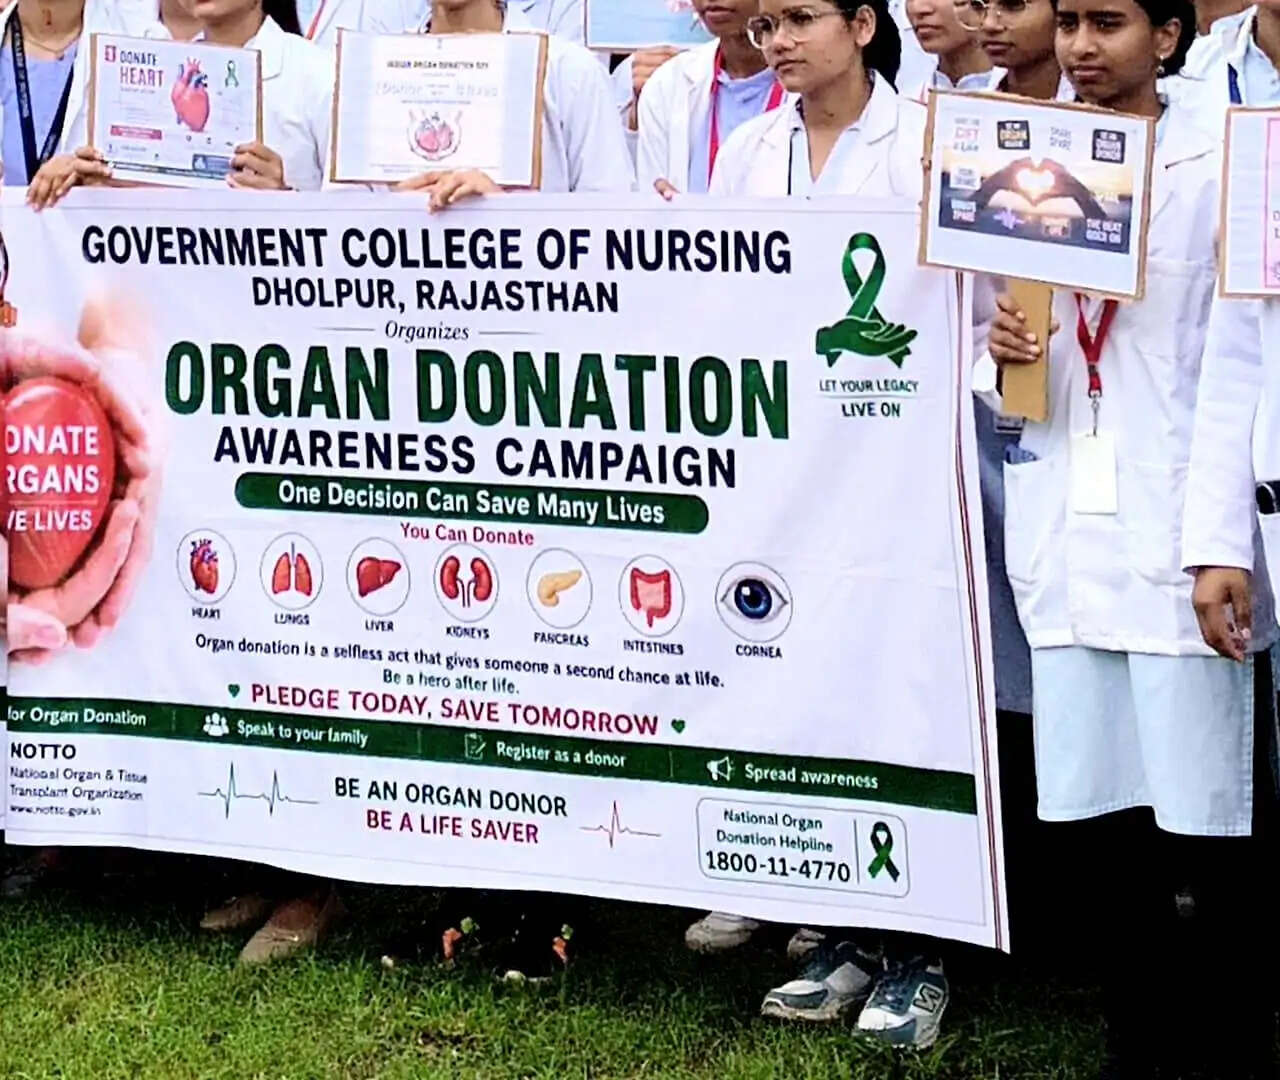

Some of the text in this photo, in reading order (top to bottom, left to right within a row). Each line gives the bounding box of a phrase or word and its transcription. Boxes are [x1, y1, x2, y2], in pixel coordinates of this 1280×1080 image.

[120, 50, 157, 66] DONATE
[120, 66, 164, 88] HEART
[81, 224, 792, 274] GOVERNMENT COLLEGE OF NURSING
[252, 276, 619, 315] DHOLPUR, RAJASTHAN
[384, 321, 469, 343] Organizes
[165, 341, 790, 439] ORGAN DONATION
[819, 379, 919, 393] LET YOUR LEGACY
[841, 402, 901, 417] LIVE ON
[214, 427, 736, 489] AWARENESS CAMPAIGN
[278, 479, 666, 524] One Decision Can Save Many Lives
[33, 508, 93, 531] LIVES
[399, 522, 535, 546] You Can Donate
[191, 608, 221, 620] HEART
[274, 613, 310, 626] LUNGS
[365, 620, 394, 632] LIVER
[446, 626, 490, 640] KIDNEYS
[533, 632, 590, 647] PANCREAS
[623, 639, 684, 656] INTESTINES
[195, 633, 725, 688] Organ donation is a selfless act that gives someone a second chance at life.
[735, 644, 783, 659] CORNEA
[383, 669, 520, 694] Be a hero after life.
[30, 707, 79, 726] Organ
[83, 707, 147, 727] Donation
[251, 683, 658, 736] PLEDGE TODAY, SAVE TOMORROW
[237, 719, 368, 749] Speak to your family
[10, 742, 77, 760] NOTTO
[496, 741, 626, 768] Register as a donor
[10, 766, 148, 784] National Organ & Tissue
[744, 762, 879, 790] Spread awareness
[10, 784, 143, 801] Transplant Organization
[335, 776, 569, 817] BE AN ORGAN DONOR
[366, 809, 539, 844] BE A LIFE SAVER
[723, 808, 823, 832] National Organ
[716, 829, 833, 854] Donation Helpline
[705, 850, 851, 883] 1800-11-4770
